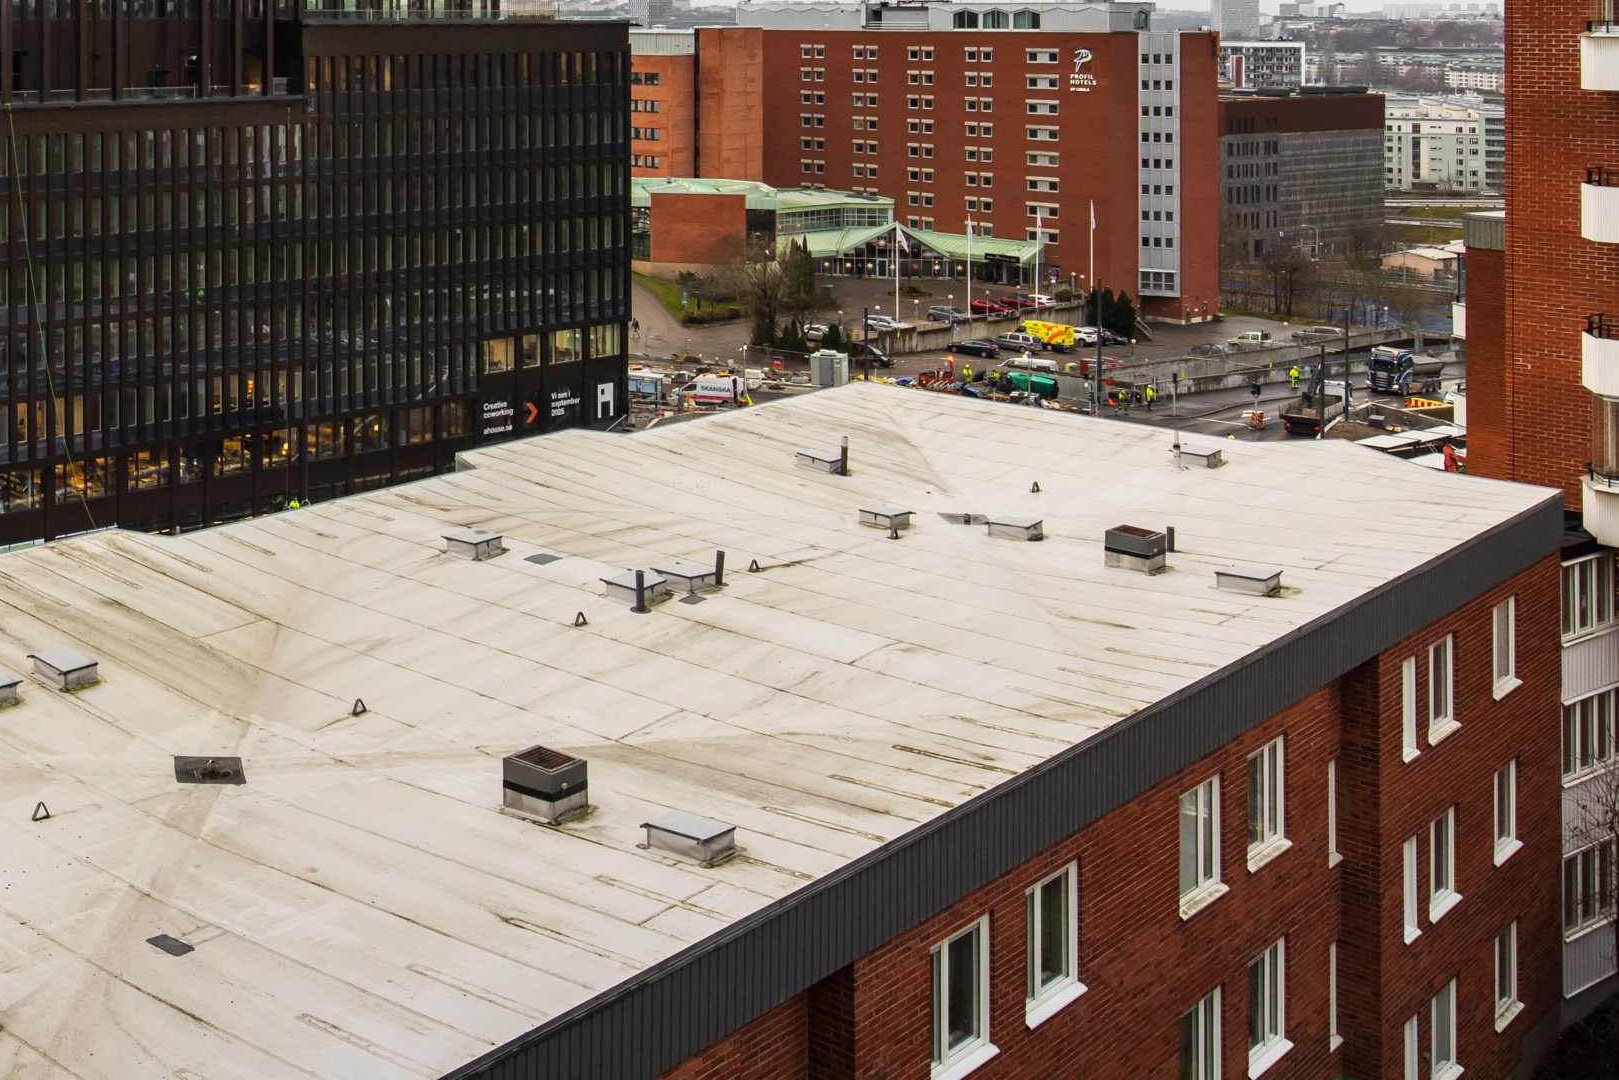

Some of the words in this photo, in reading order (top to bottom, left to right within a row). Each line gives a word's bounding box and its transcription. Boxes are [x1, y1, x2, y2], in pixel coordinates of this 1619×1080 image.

[700, 385, 731, 393] SKANSKA
[551, 392, 559, 400] Vi
[559, 391, 568, 399] ses
[483, 401, 508, 411] Creative
[551, 397, 581, 408] september
[483, 408, 514, 419] coworking
[551, 408, 565, 417] 2025
[483, 424, 513, 435] ahouse.se
